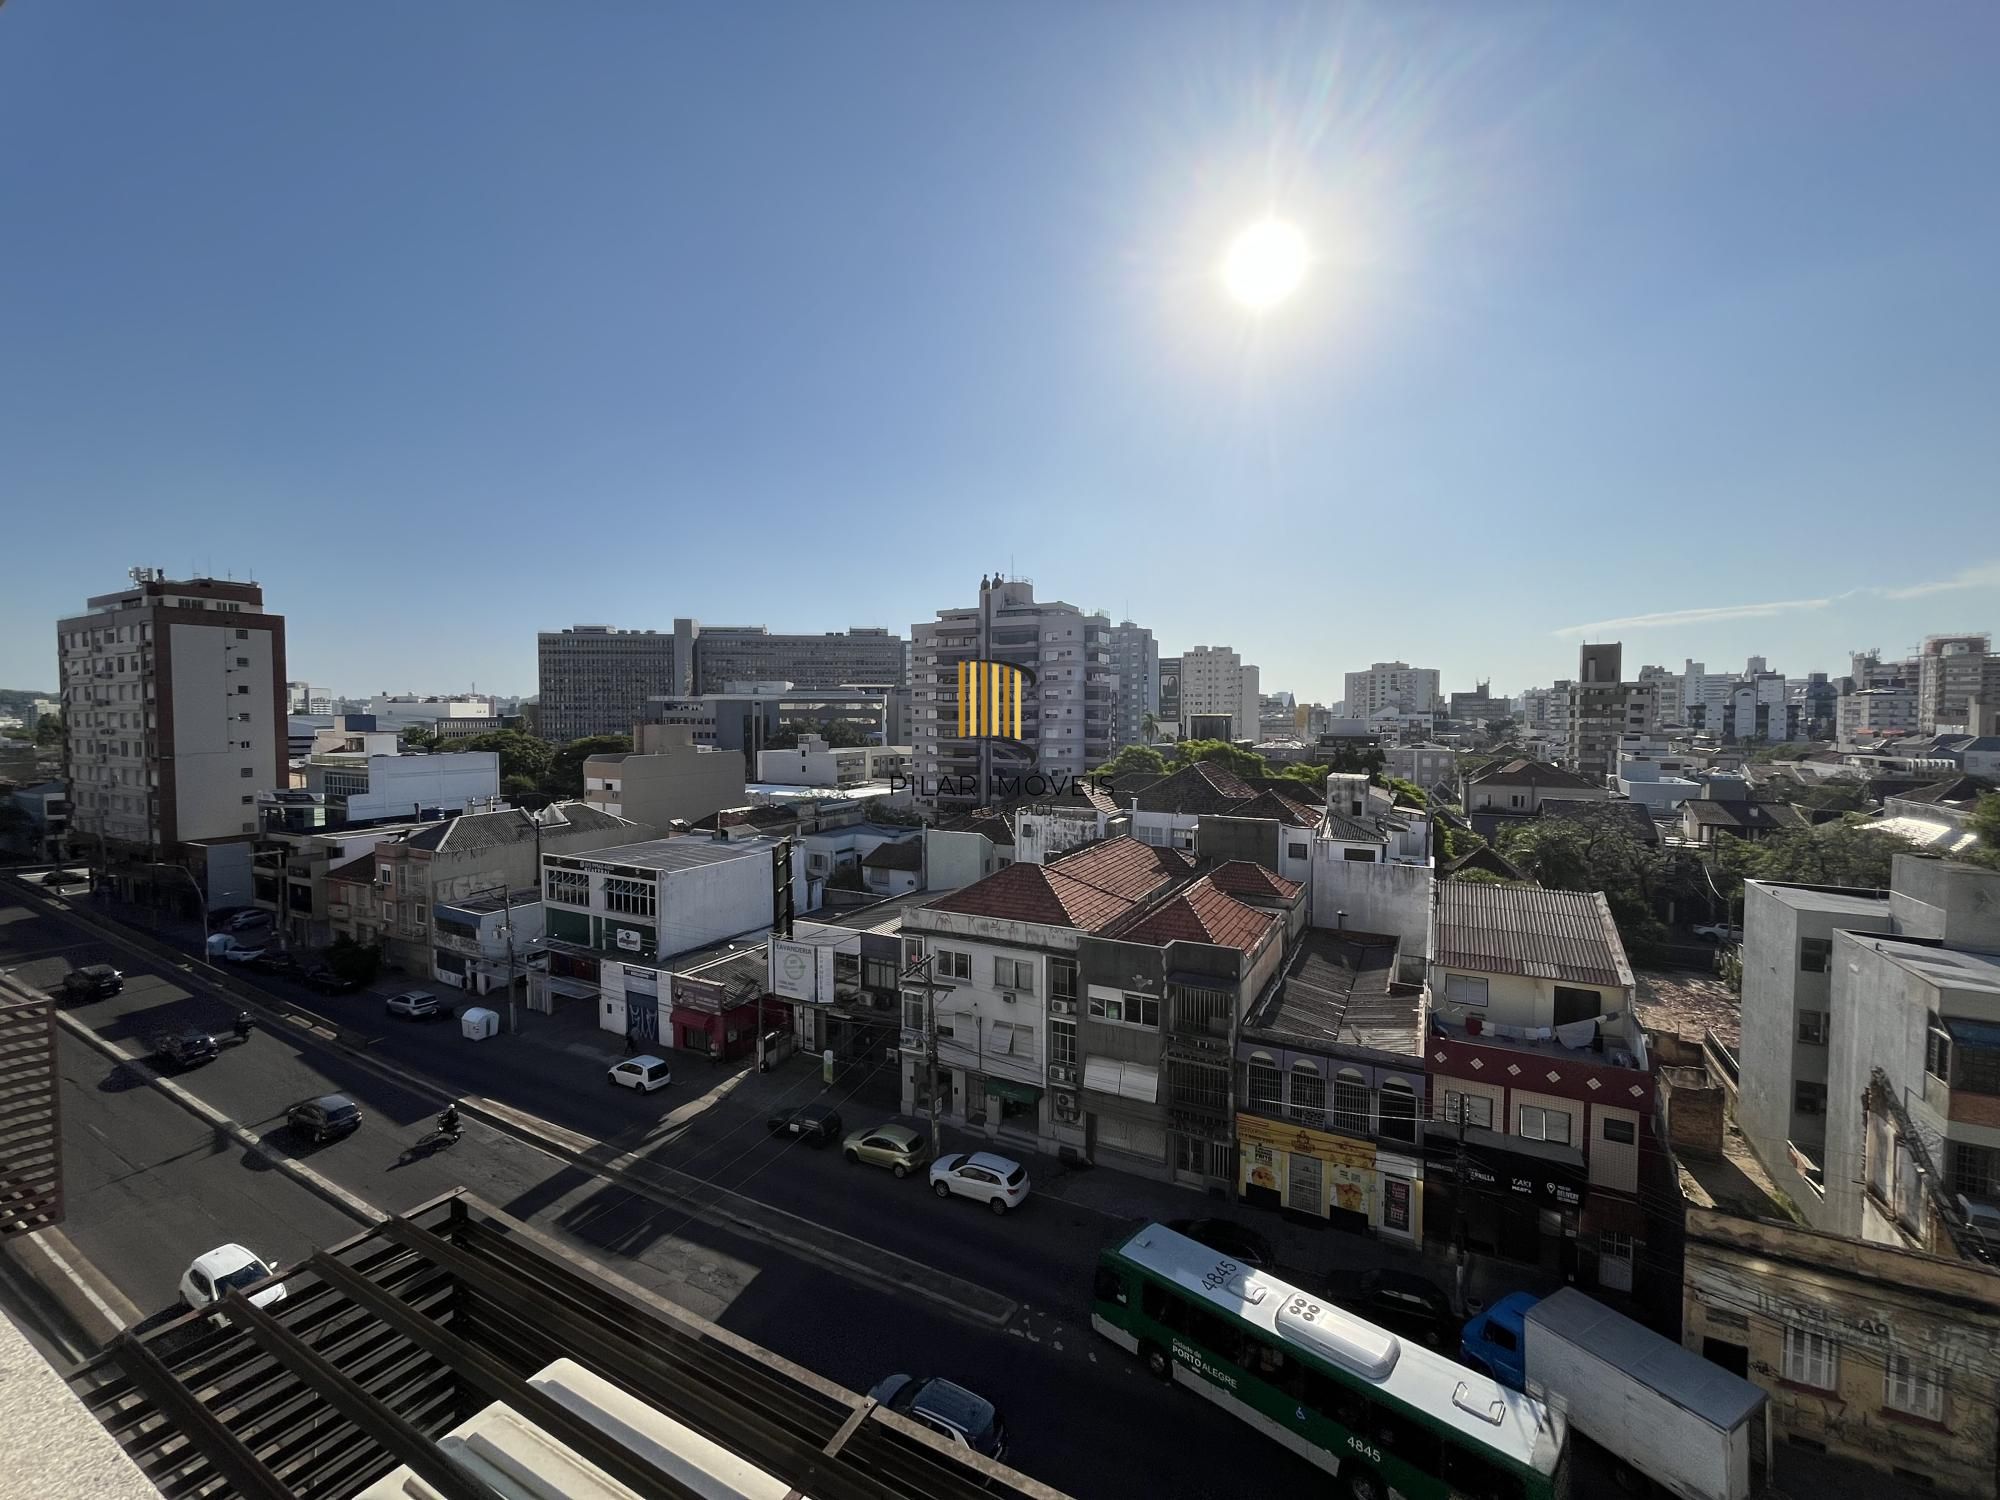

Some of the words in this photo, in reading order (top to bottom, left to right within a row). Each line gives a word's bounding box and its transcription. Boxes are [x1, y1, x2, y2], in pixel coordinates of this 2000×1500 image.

[776, 942, 812, 956] LAVANDERIA
[1201, 1260, 1237, 1291] 4845
[1172, 1345, 1202, 1368] PORTO
[1201, 1362, 1238, 1390] ALEGRE
[1346, 1436, 1381, 1463] 4845
